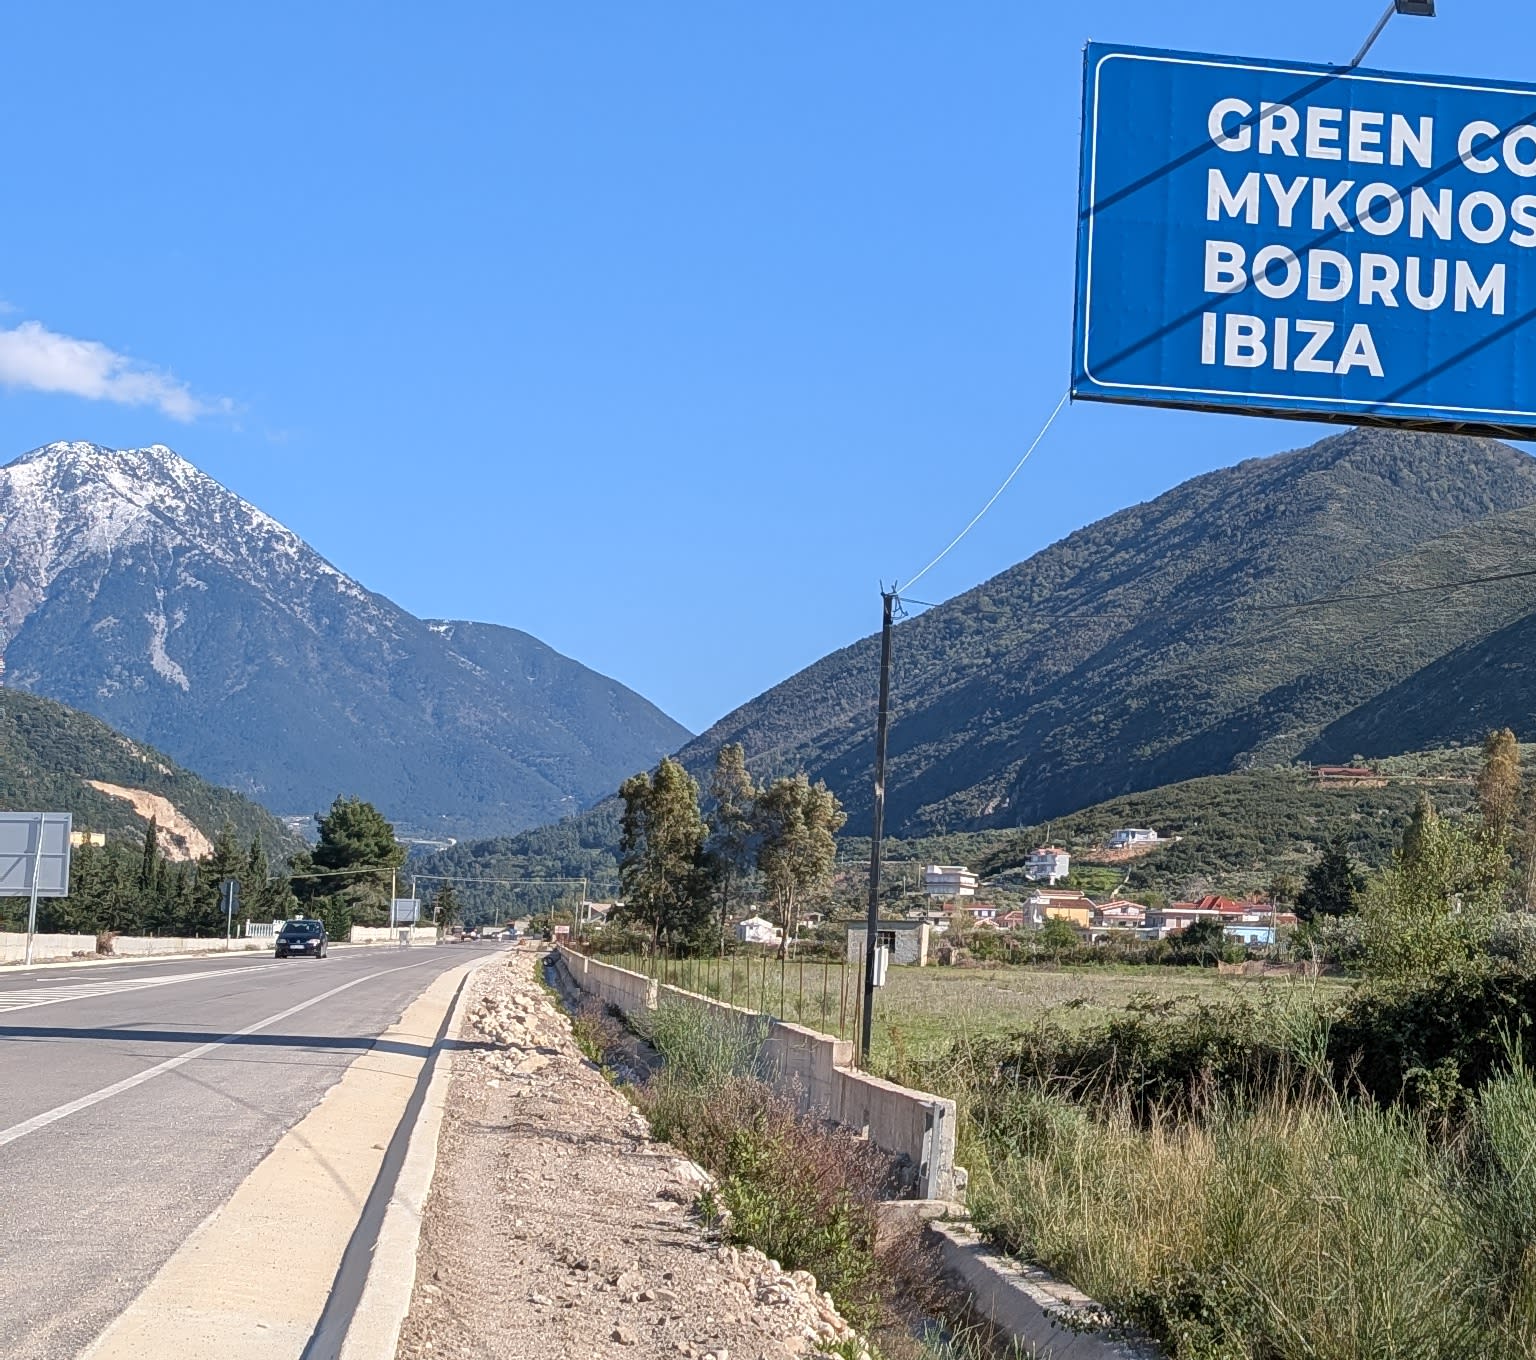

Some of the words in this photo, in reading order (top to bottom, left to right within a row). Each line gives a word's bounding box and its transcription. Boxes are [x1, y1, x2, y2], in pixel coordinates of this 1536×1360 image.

[1207, 97, 1434, 169] GREEN
[1204, 239, 1506, 315] BODRUM
[1201, 311, 1385, 377] IBIZA
